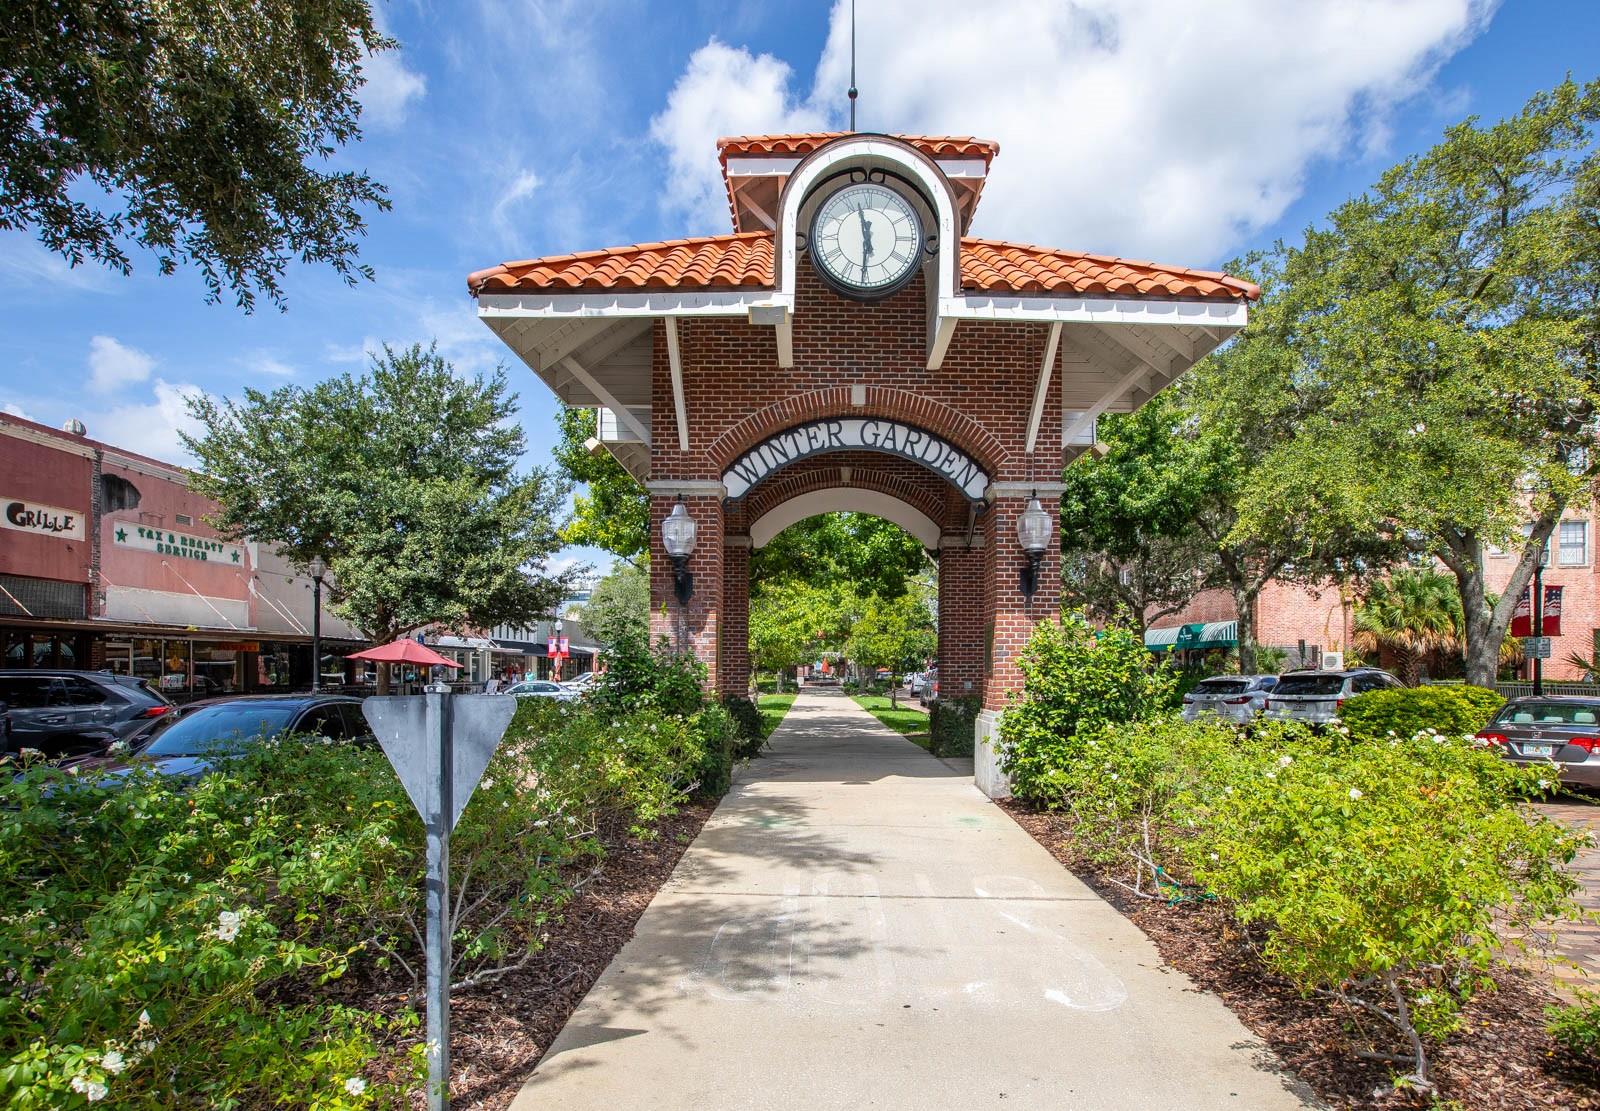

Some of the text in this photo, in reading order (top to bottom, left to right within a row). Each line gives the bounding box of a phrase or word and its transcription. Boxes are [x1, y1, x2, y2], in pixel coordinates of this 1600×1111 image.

[731, 419, 981, 487] WINTER GARDEN
[6, 502, 75, 532] GRILLE
[138, 527, 163, 541] TAX
[180, 535, 224, 553] REALTY
[157, 542, 208, 561] SERVICE
